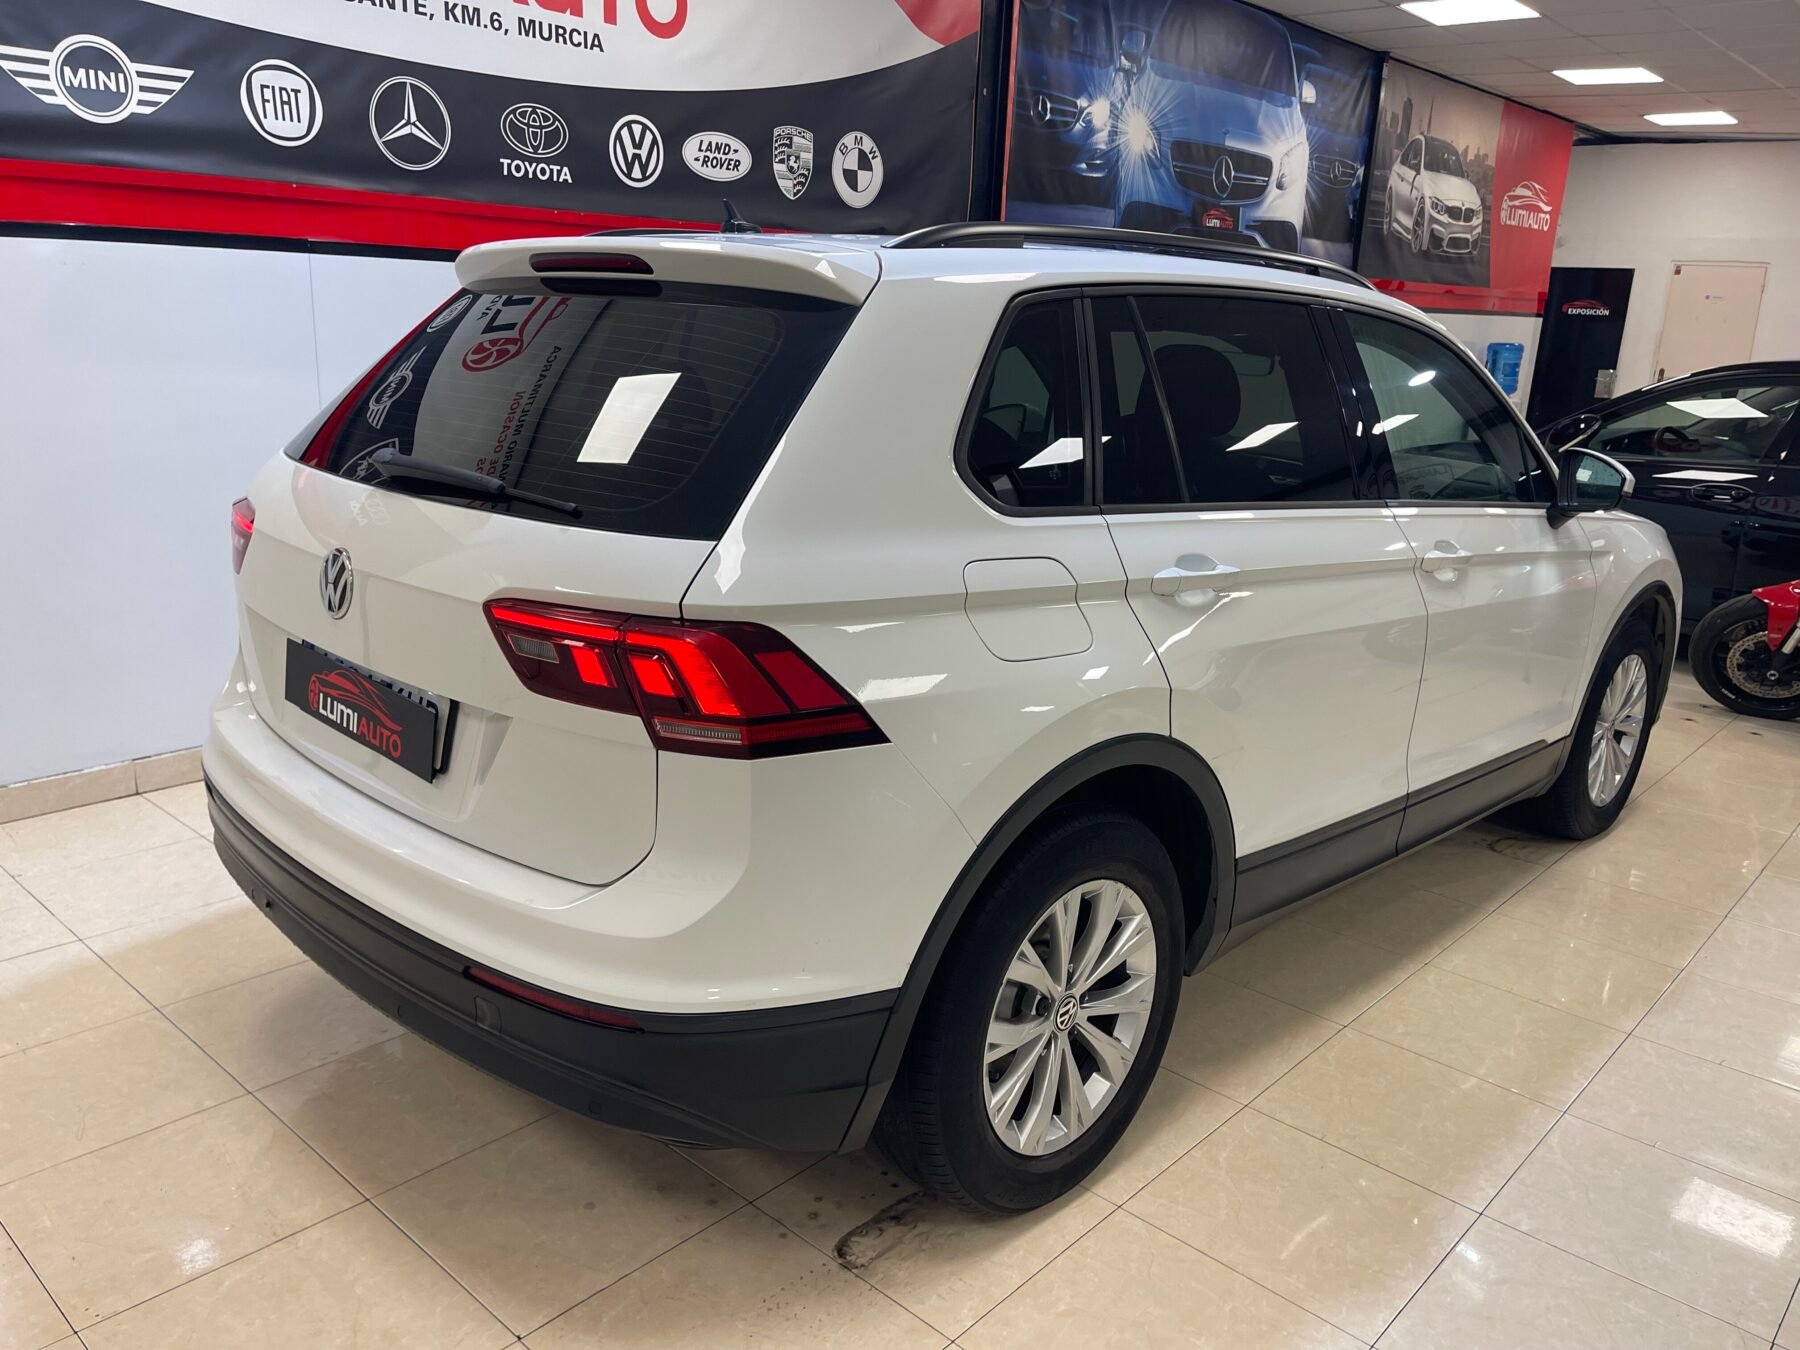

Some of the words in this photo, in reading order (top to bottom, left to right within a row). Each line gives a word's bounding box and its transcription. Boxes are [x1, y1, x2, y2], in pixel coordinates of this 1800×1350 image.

[444, 1, 509, 36] KM.6,
[517, 16, 605, 53] MURCIA
[63, 65, 126, 94] MINI
[260, 84, 301, 123] FIAT
[775, 128, 812, 141] PORSCHE
[698, 139, 730, 156] LAND
[839, 135, 878, 160] BMW
[499, 158, 573, 183] TOYOTA
[701, 156, 741, 172] ROVER
